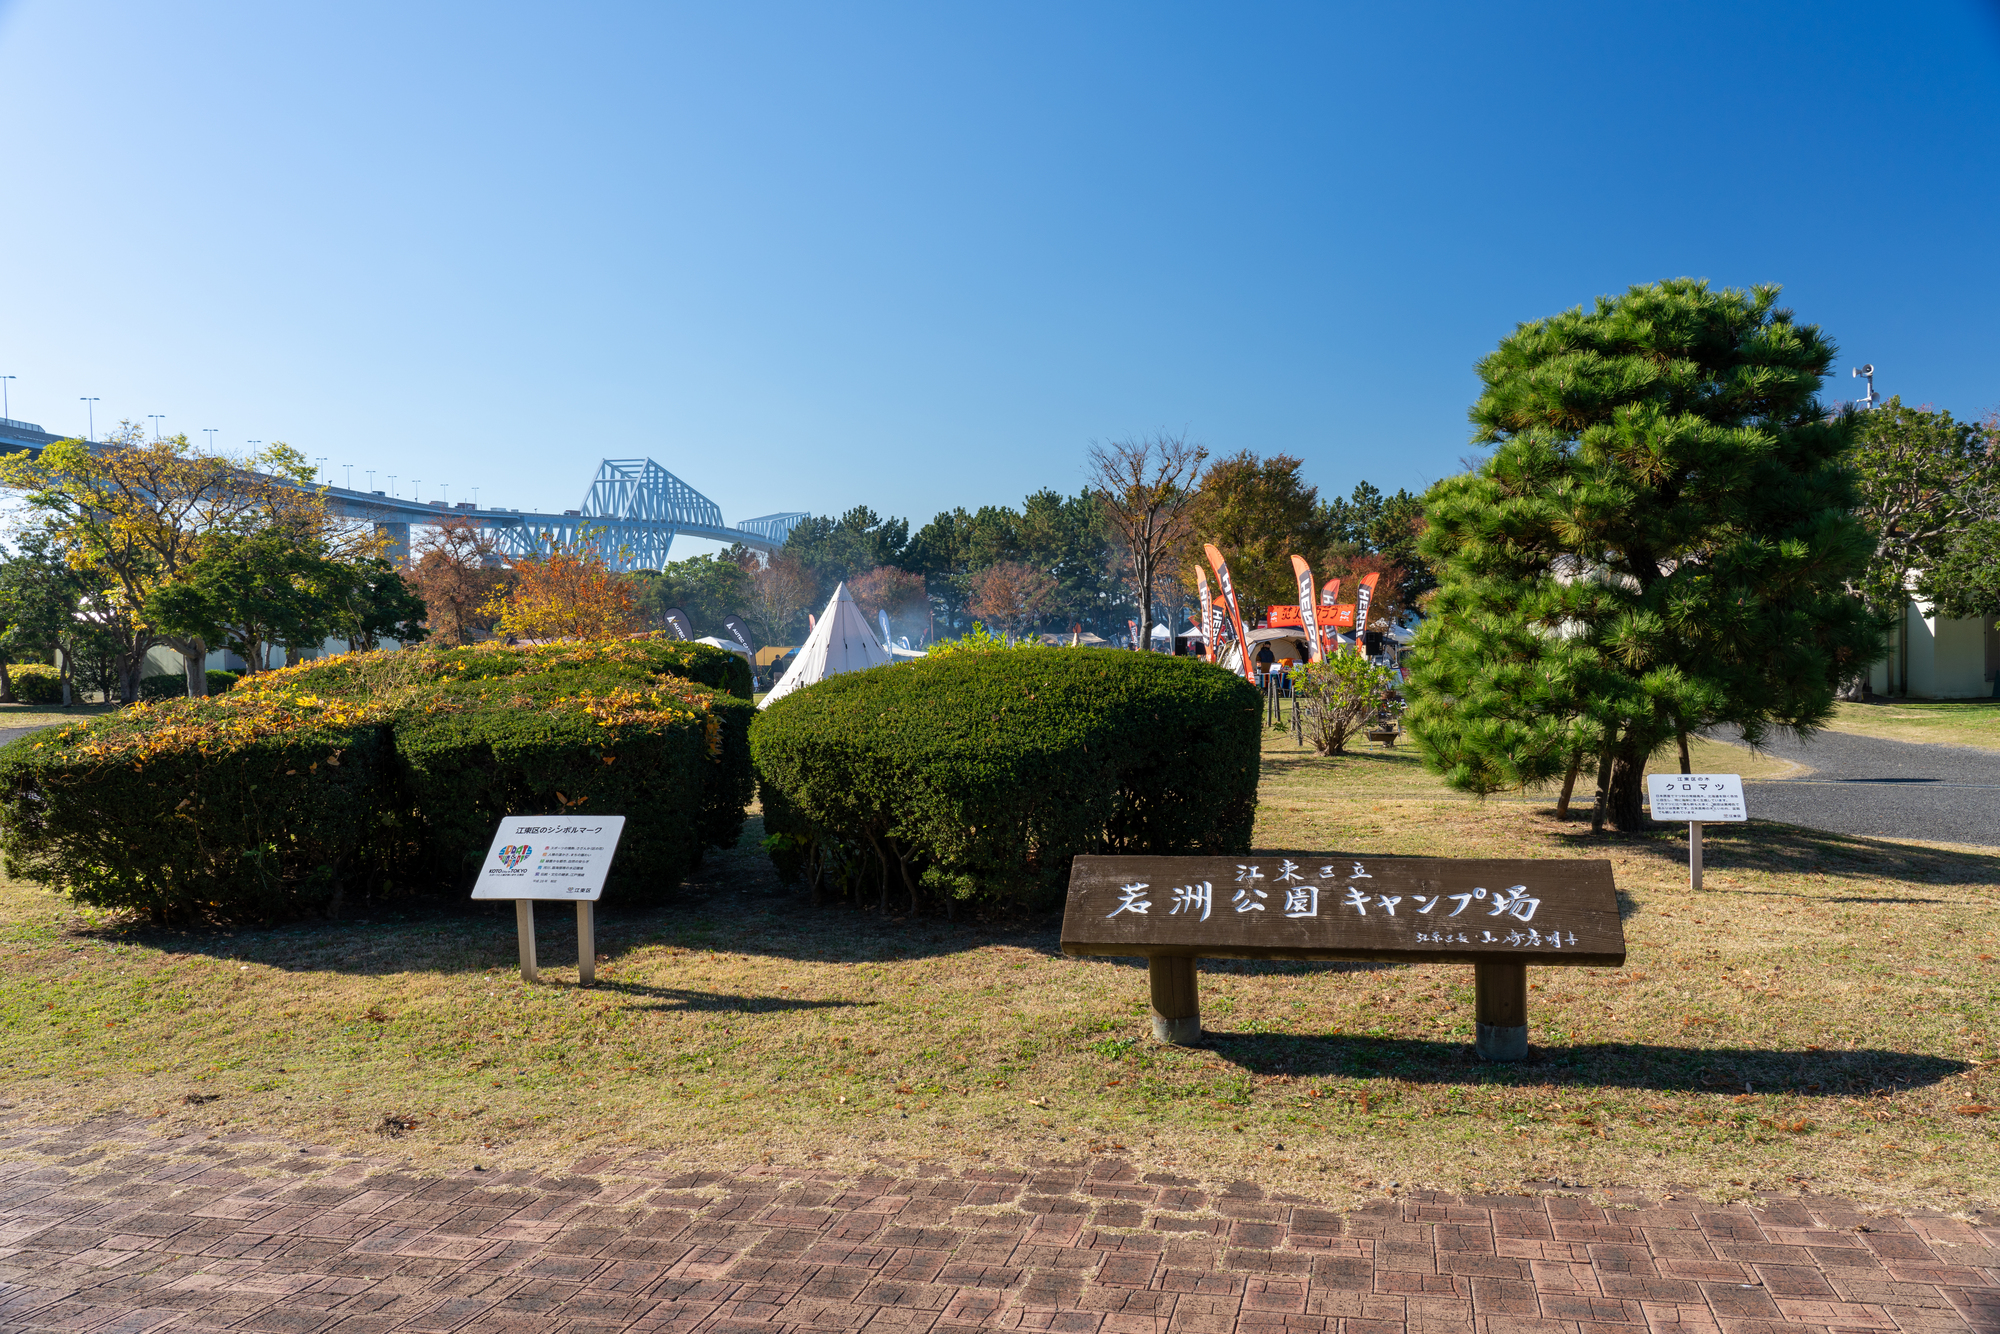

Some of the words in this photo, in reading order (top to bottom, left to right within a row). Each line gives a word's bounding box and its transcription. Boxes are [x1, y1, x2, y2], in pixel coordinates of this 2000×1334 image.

[732, 628, 745, 644] AUTEC
[1665, 783, 1725, 791] クロマツ
[515, 826, 603, 834] 江東区のシンボルマーク
[498, 845, 533, 856] SPORTS
[1234, 858, 1373, 882] 江東区立
[1106, 879, 1541, 923] 若洲公園キャンプ場
